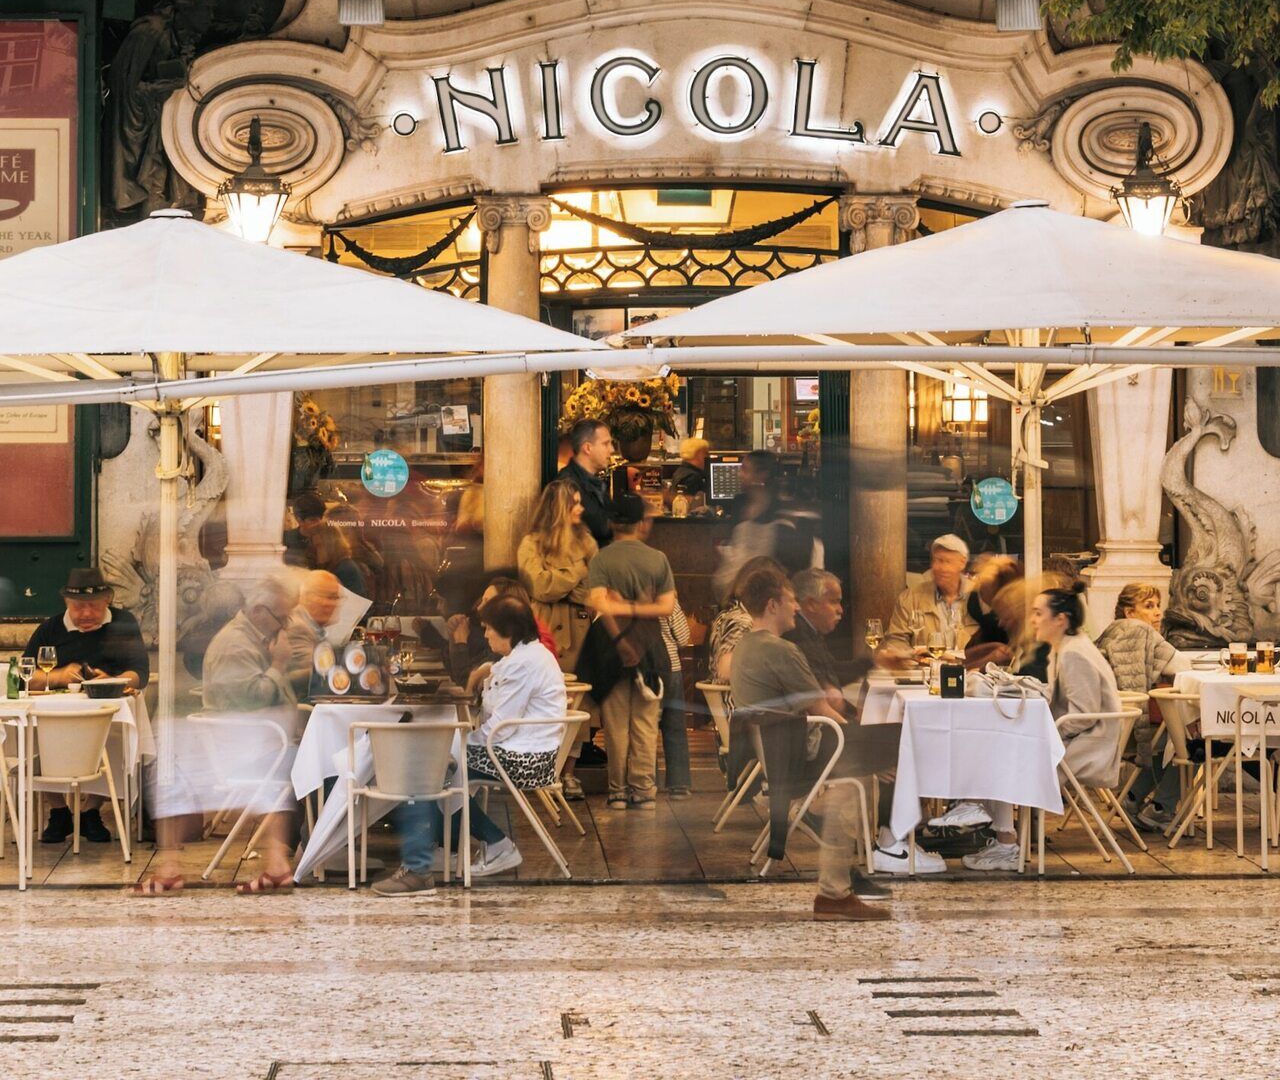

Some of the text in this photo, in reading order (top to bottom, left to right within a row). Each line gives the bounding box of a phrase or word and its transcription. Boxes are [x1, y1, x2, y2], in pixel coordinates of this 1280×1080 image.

[431, 56, 962, 158] NICOLA
[18, 231, 52, 241] YEAR
[327, 519, 357, 527] Welcome
[371, 519, 407, 527] NICOLA
